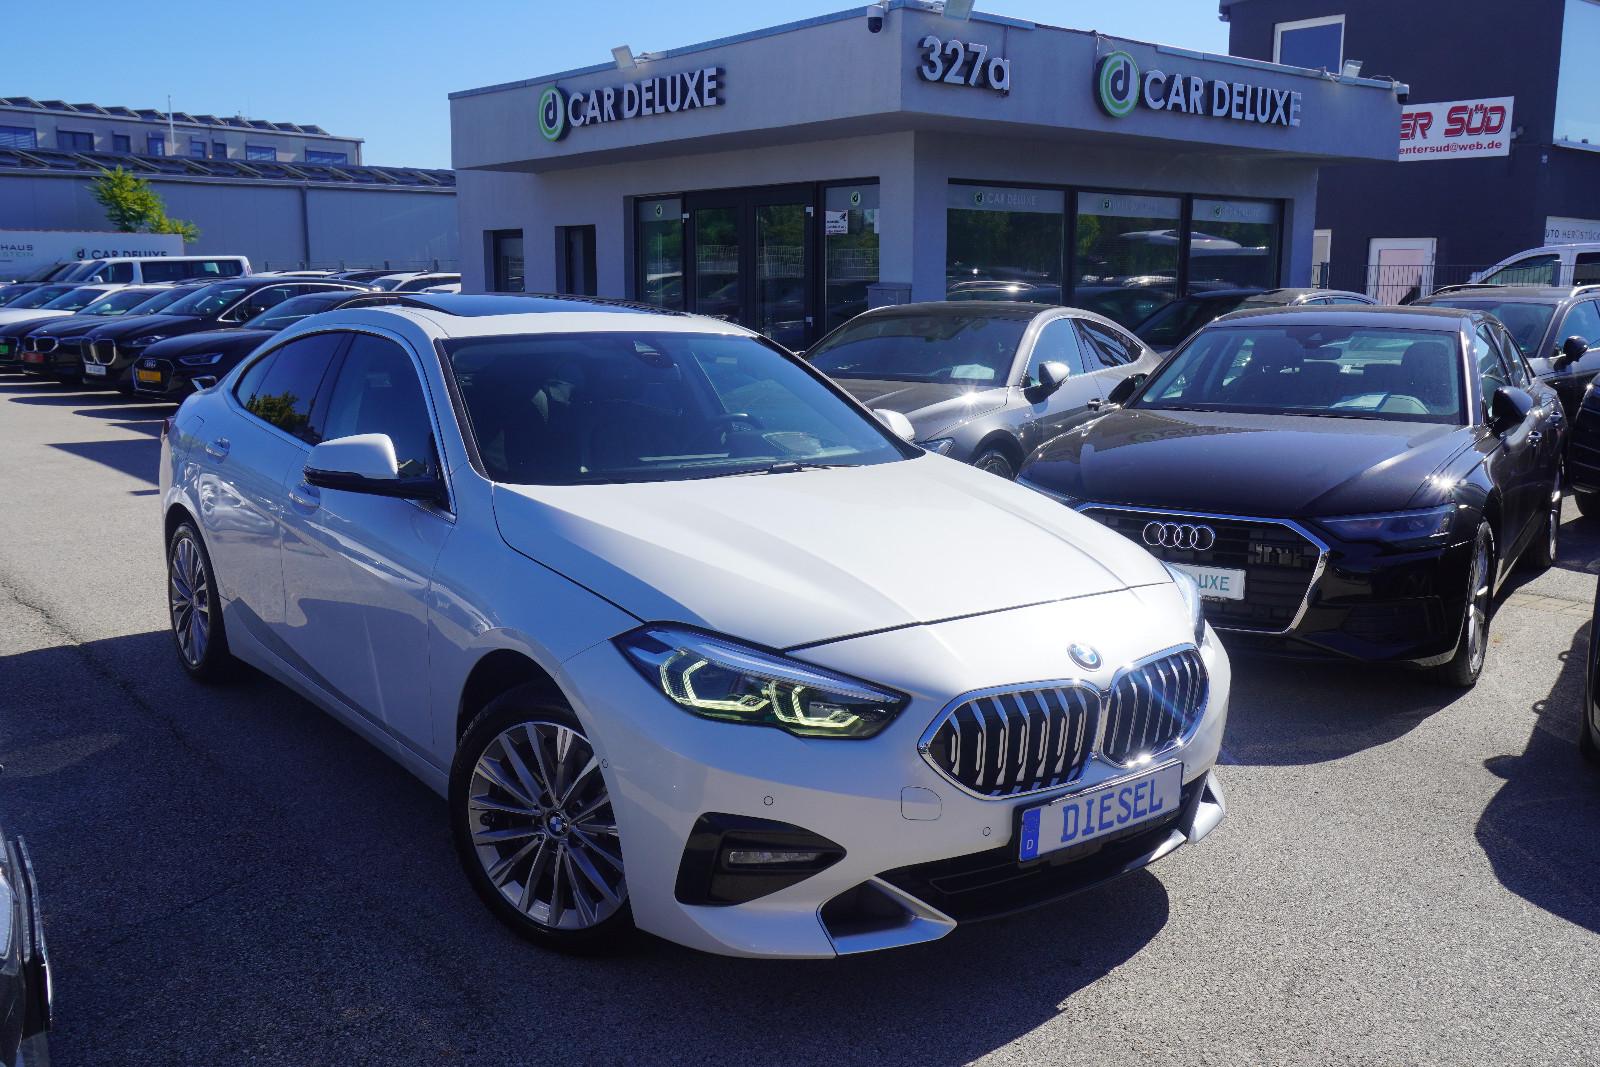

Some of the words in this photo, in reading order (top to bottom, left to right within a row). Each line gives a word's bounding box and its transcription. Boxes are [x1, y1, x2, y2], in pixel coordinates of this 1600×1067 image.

[921, 35, 1010, 91] 327a
[567, 87, 616, 127] CAR
[623, 66, 718, 119] DELUXE
[1144, 69, 1204, 115] CAR
[1212, 79, 1302, 128] DELUXE
[1443, 103, 1507, 138] SÜD
[91, 249, 118, 259] CAR
[1198, 573, 1230, 592] UXE
[1060, 780, 1163, 843] DIESEL
[1026, 839, 1034, 850] D
